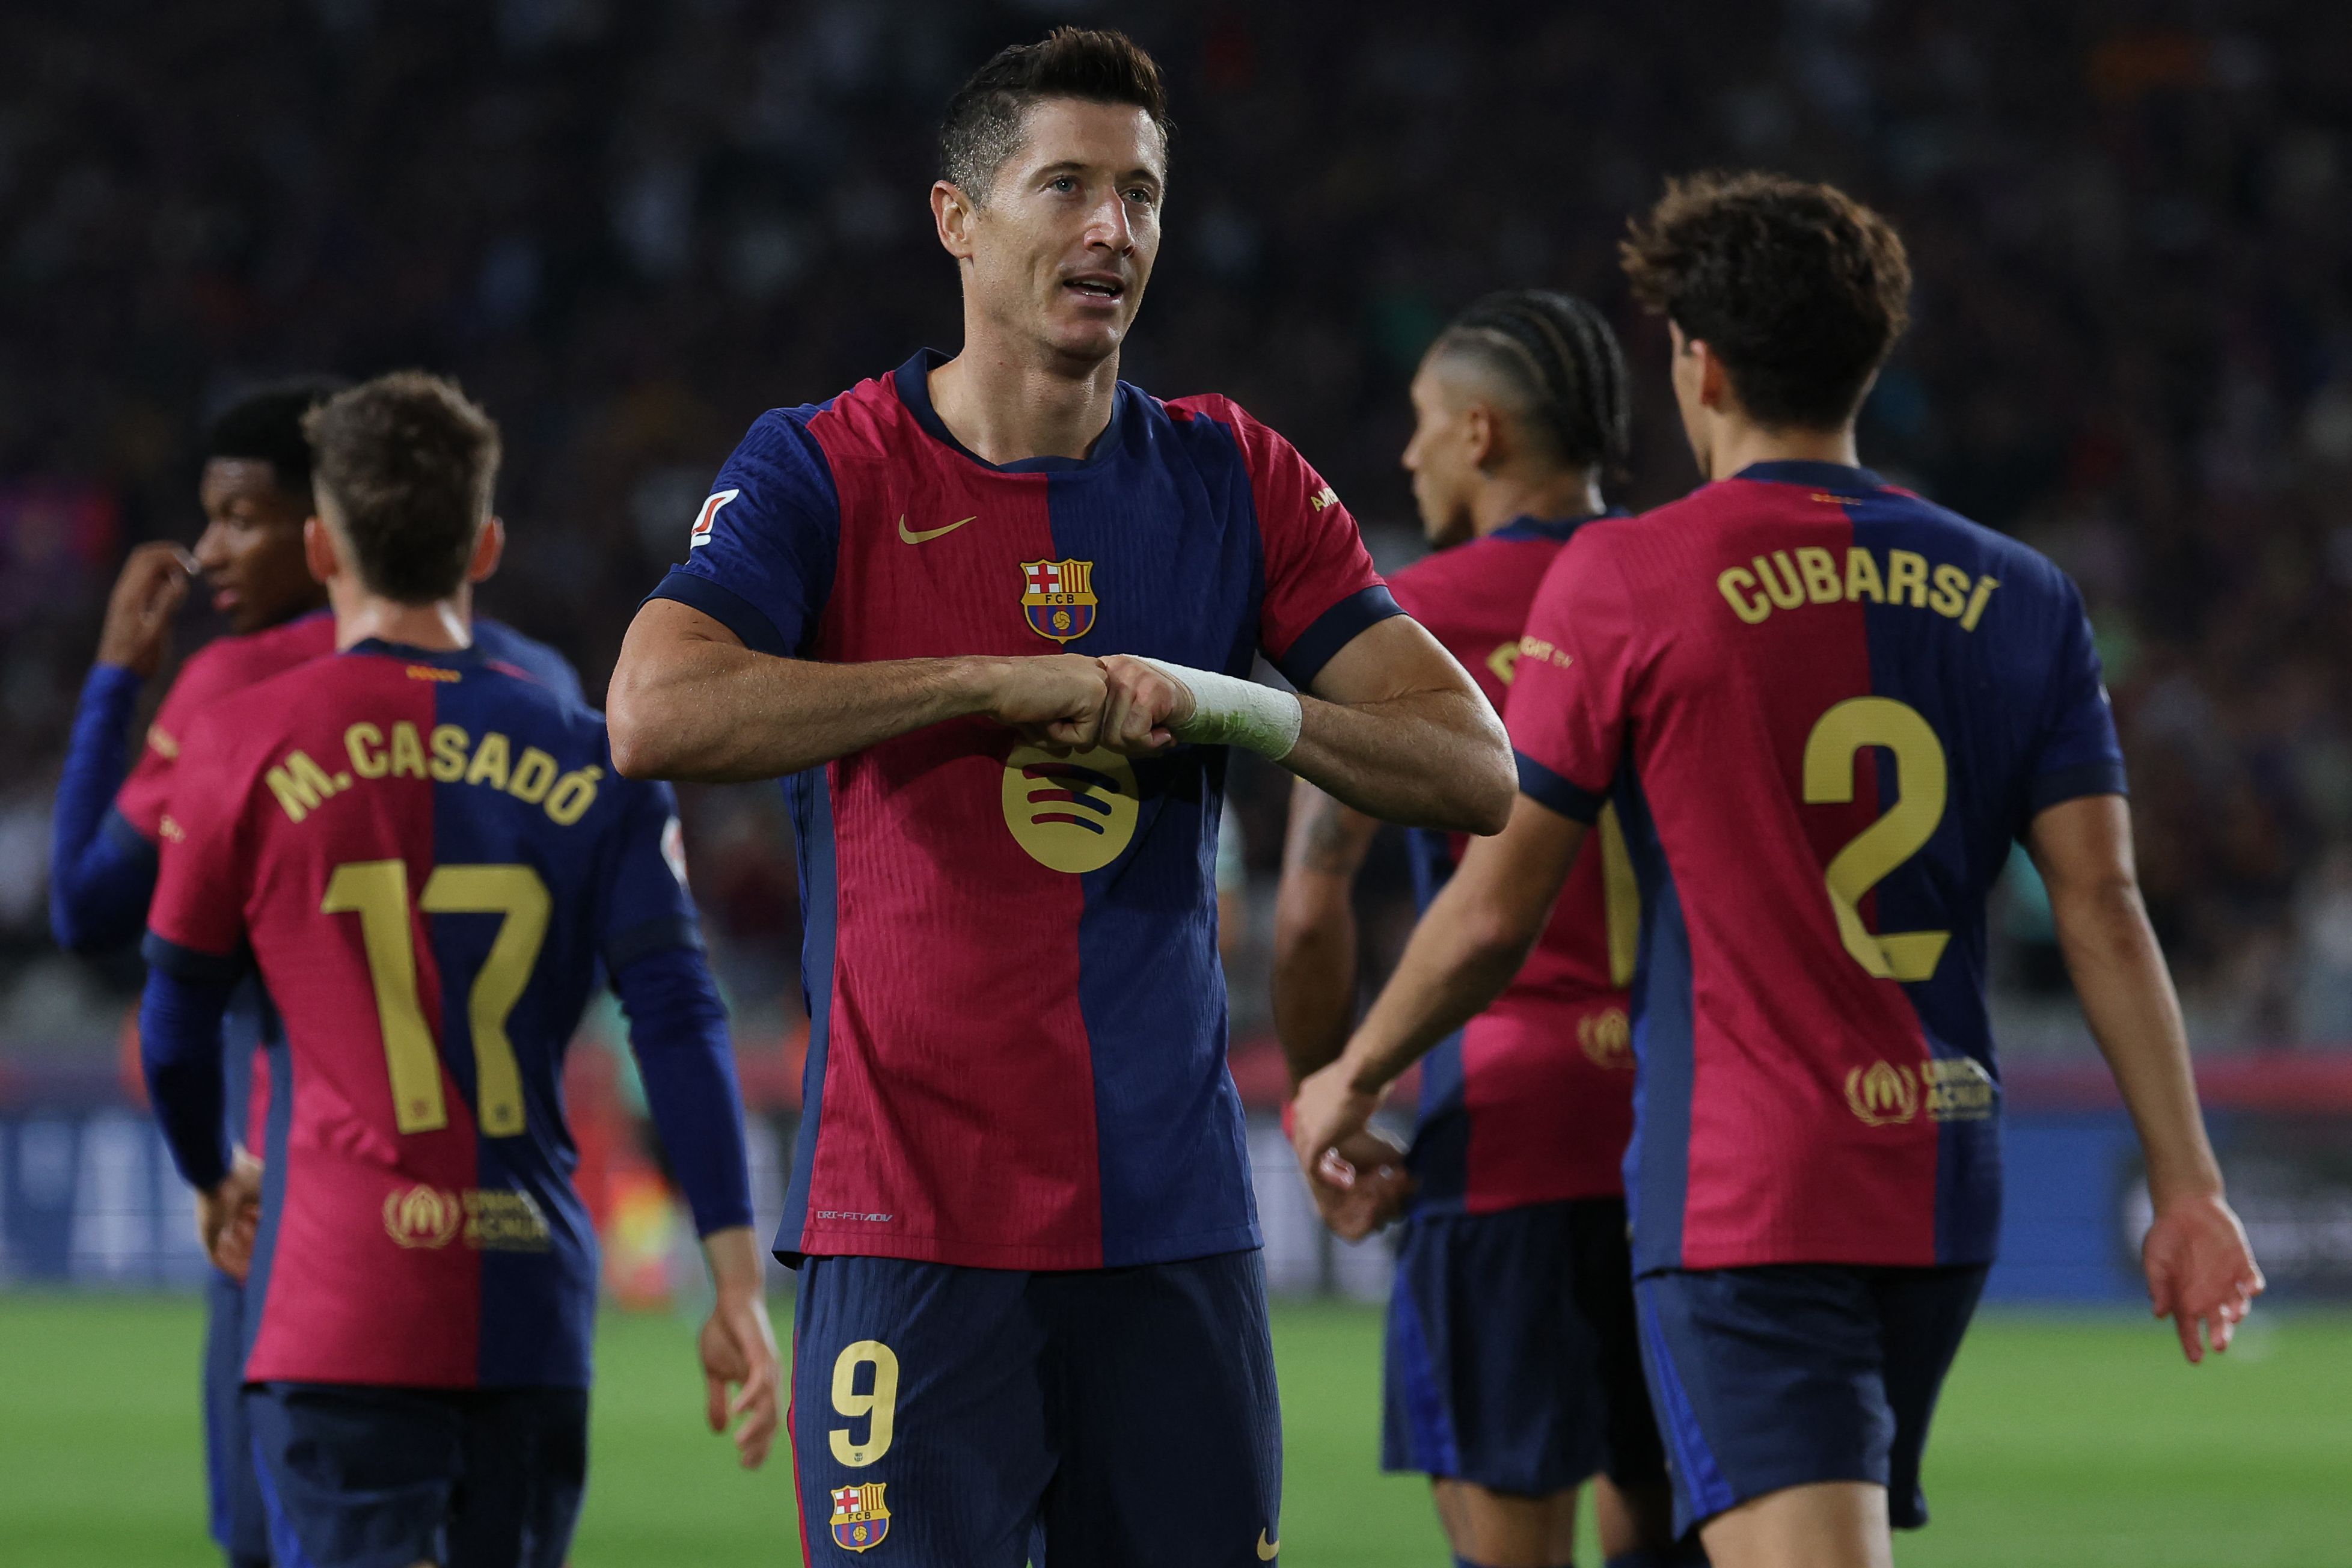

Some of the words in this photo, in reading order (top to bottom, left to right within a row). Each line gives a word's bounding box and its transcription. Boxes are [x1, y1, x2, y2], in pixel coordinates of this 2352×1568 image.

[1046, 594, 1074, 604] FCB
[1717, 547, 1998, 632] CUBARSÍ
[266, 750, 351, 822] M.
[345, 721, 604, 825] CASADÓ
[1804, 696, 1950, 981] 2
[321, 859, 551, 1136] 17
[829, 1340, 899, 1467] 9
[848, 1511, 871, 1522] FCB
